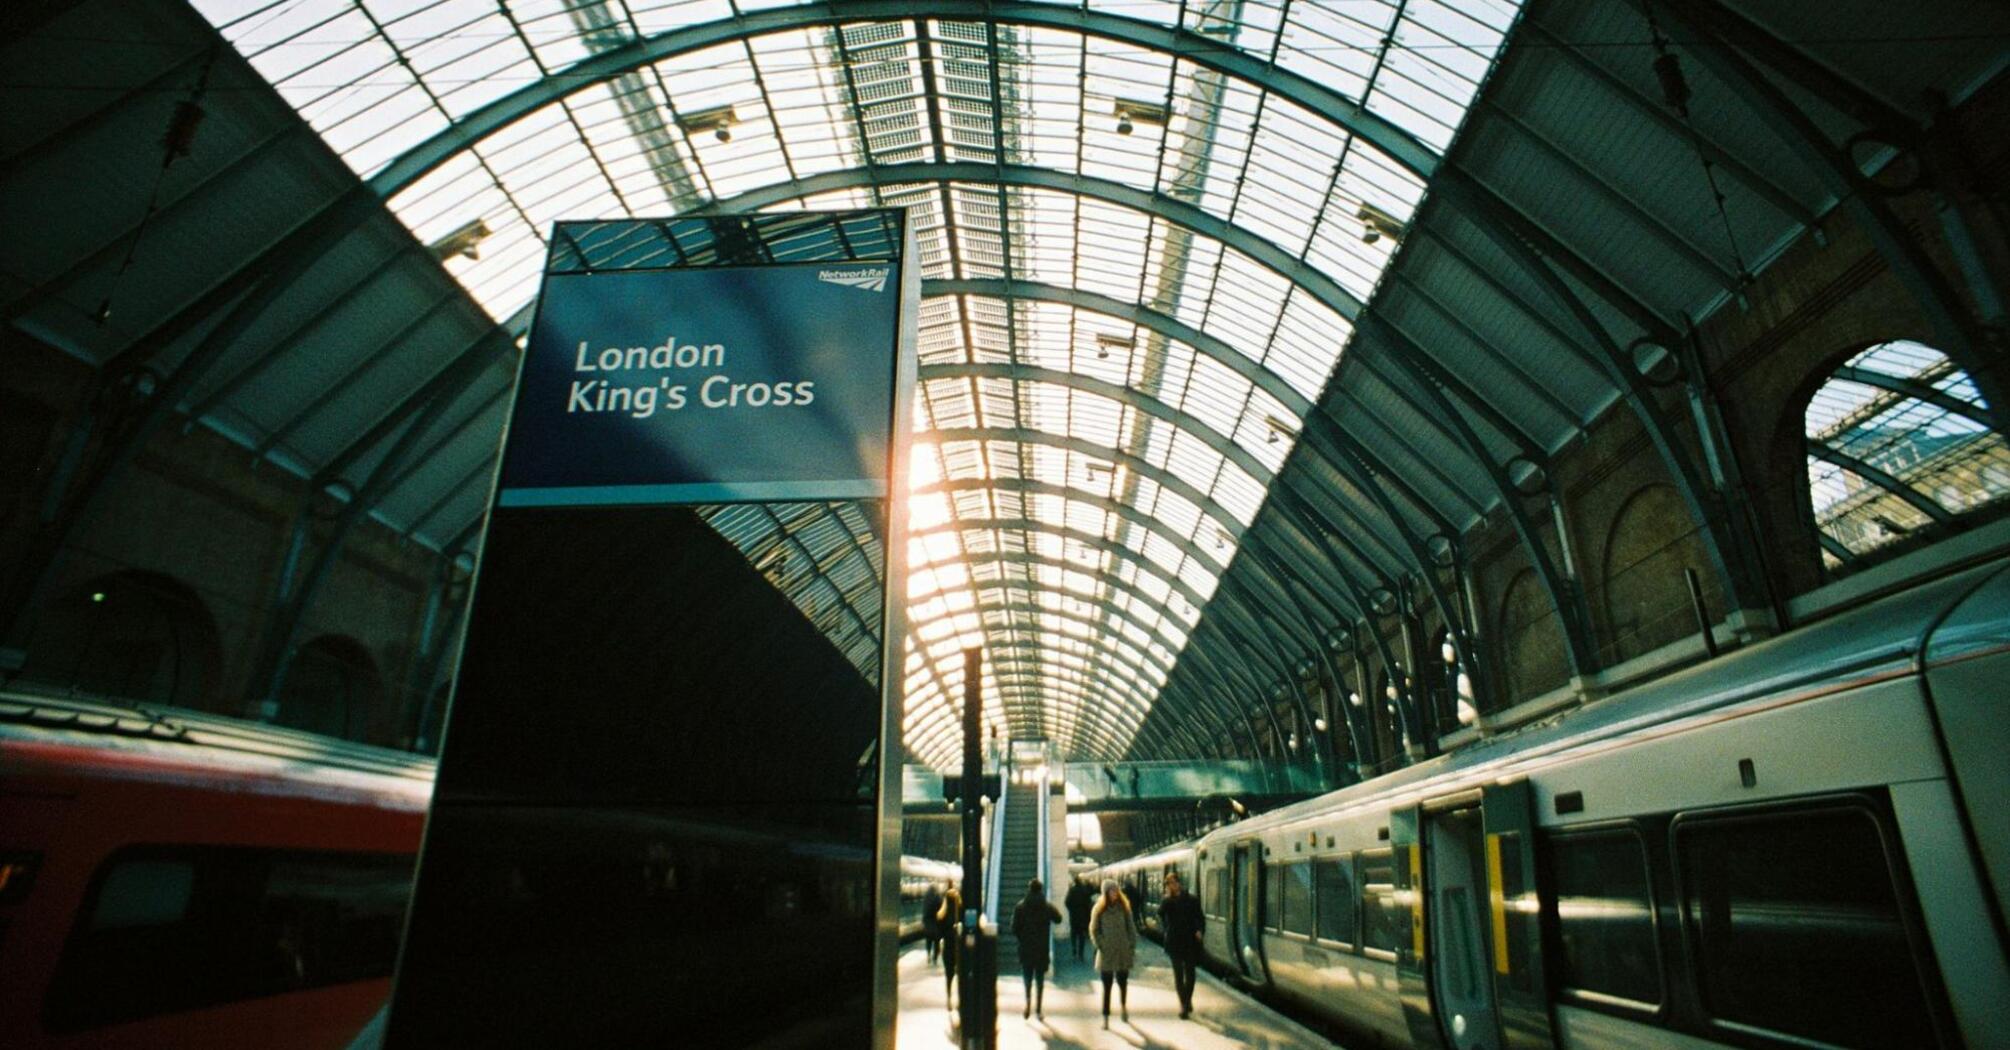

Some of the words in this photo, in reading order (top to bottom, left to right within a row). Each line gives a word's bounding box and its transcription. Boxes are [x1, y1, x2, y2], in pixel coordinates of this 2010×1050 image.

[575, 337, 724, 371] London
[567, 376, 687, 418] King's
[701, 375, 814, 408] Cross
